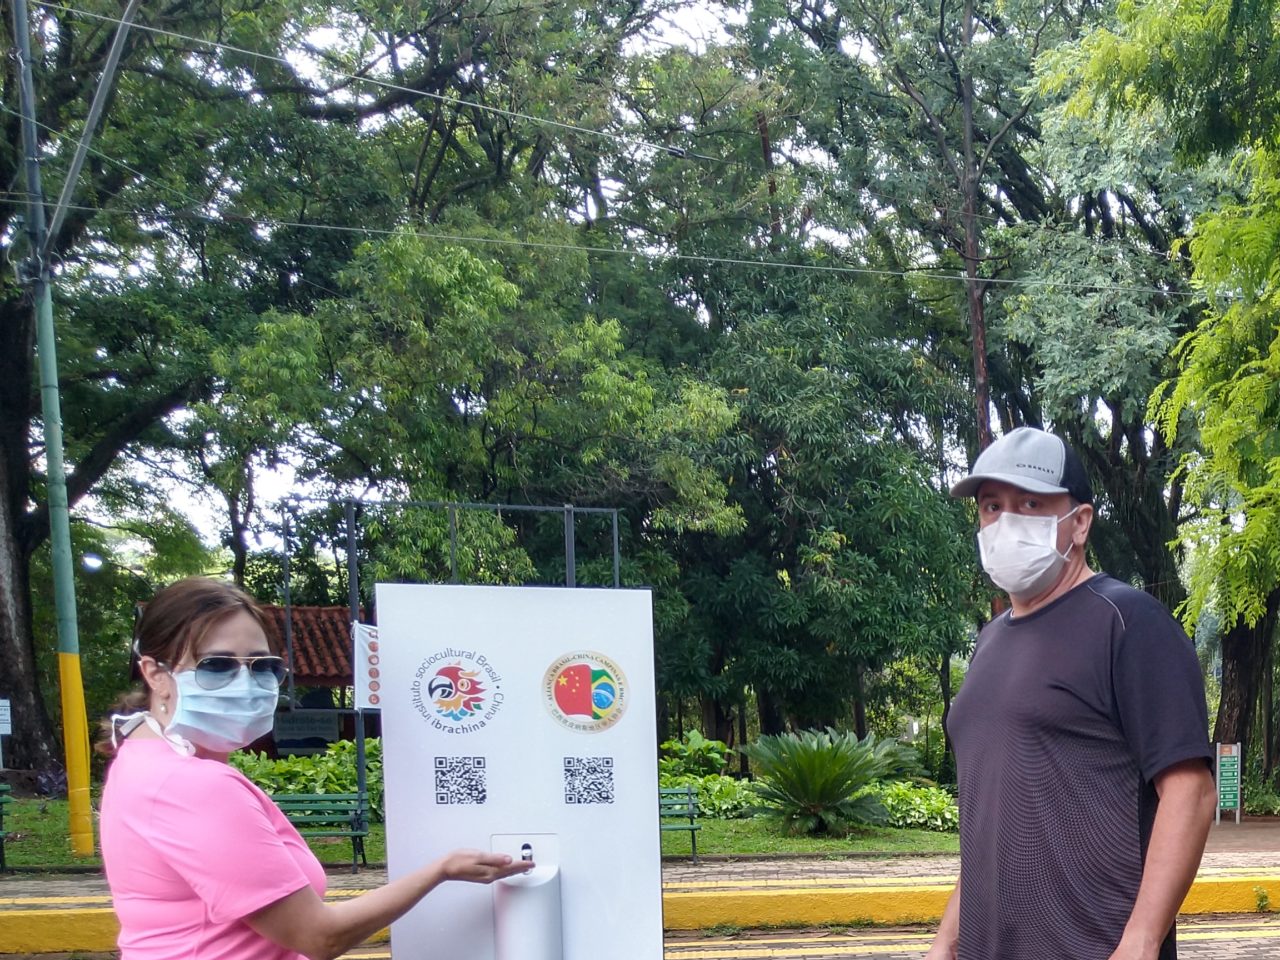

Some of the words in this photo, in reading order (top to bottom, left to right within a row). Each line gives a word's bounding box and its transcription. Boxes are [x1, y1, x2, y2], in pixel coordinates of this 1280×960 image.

[415, 648, 476, 679] sociocultural
[476, 655, 501, 682] Brasil
[484, 693, 504, 720] China
